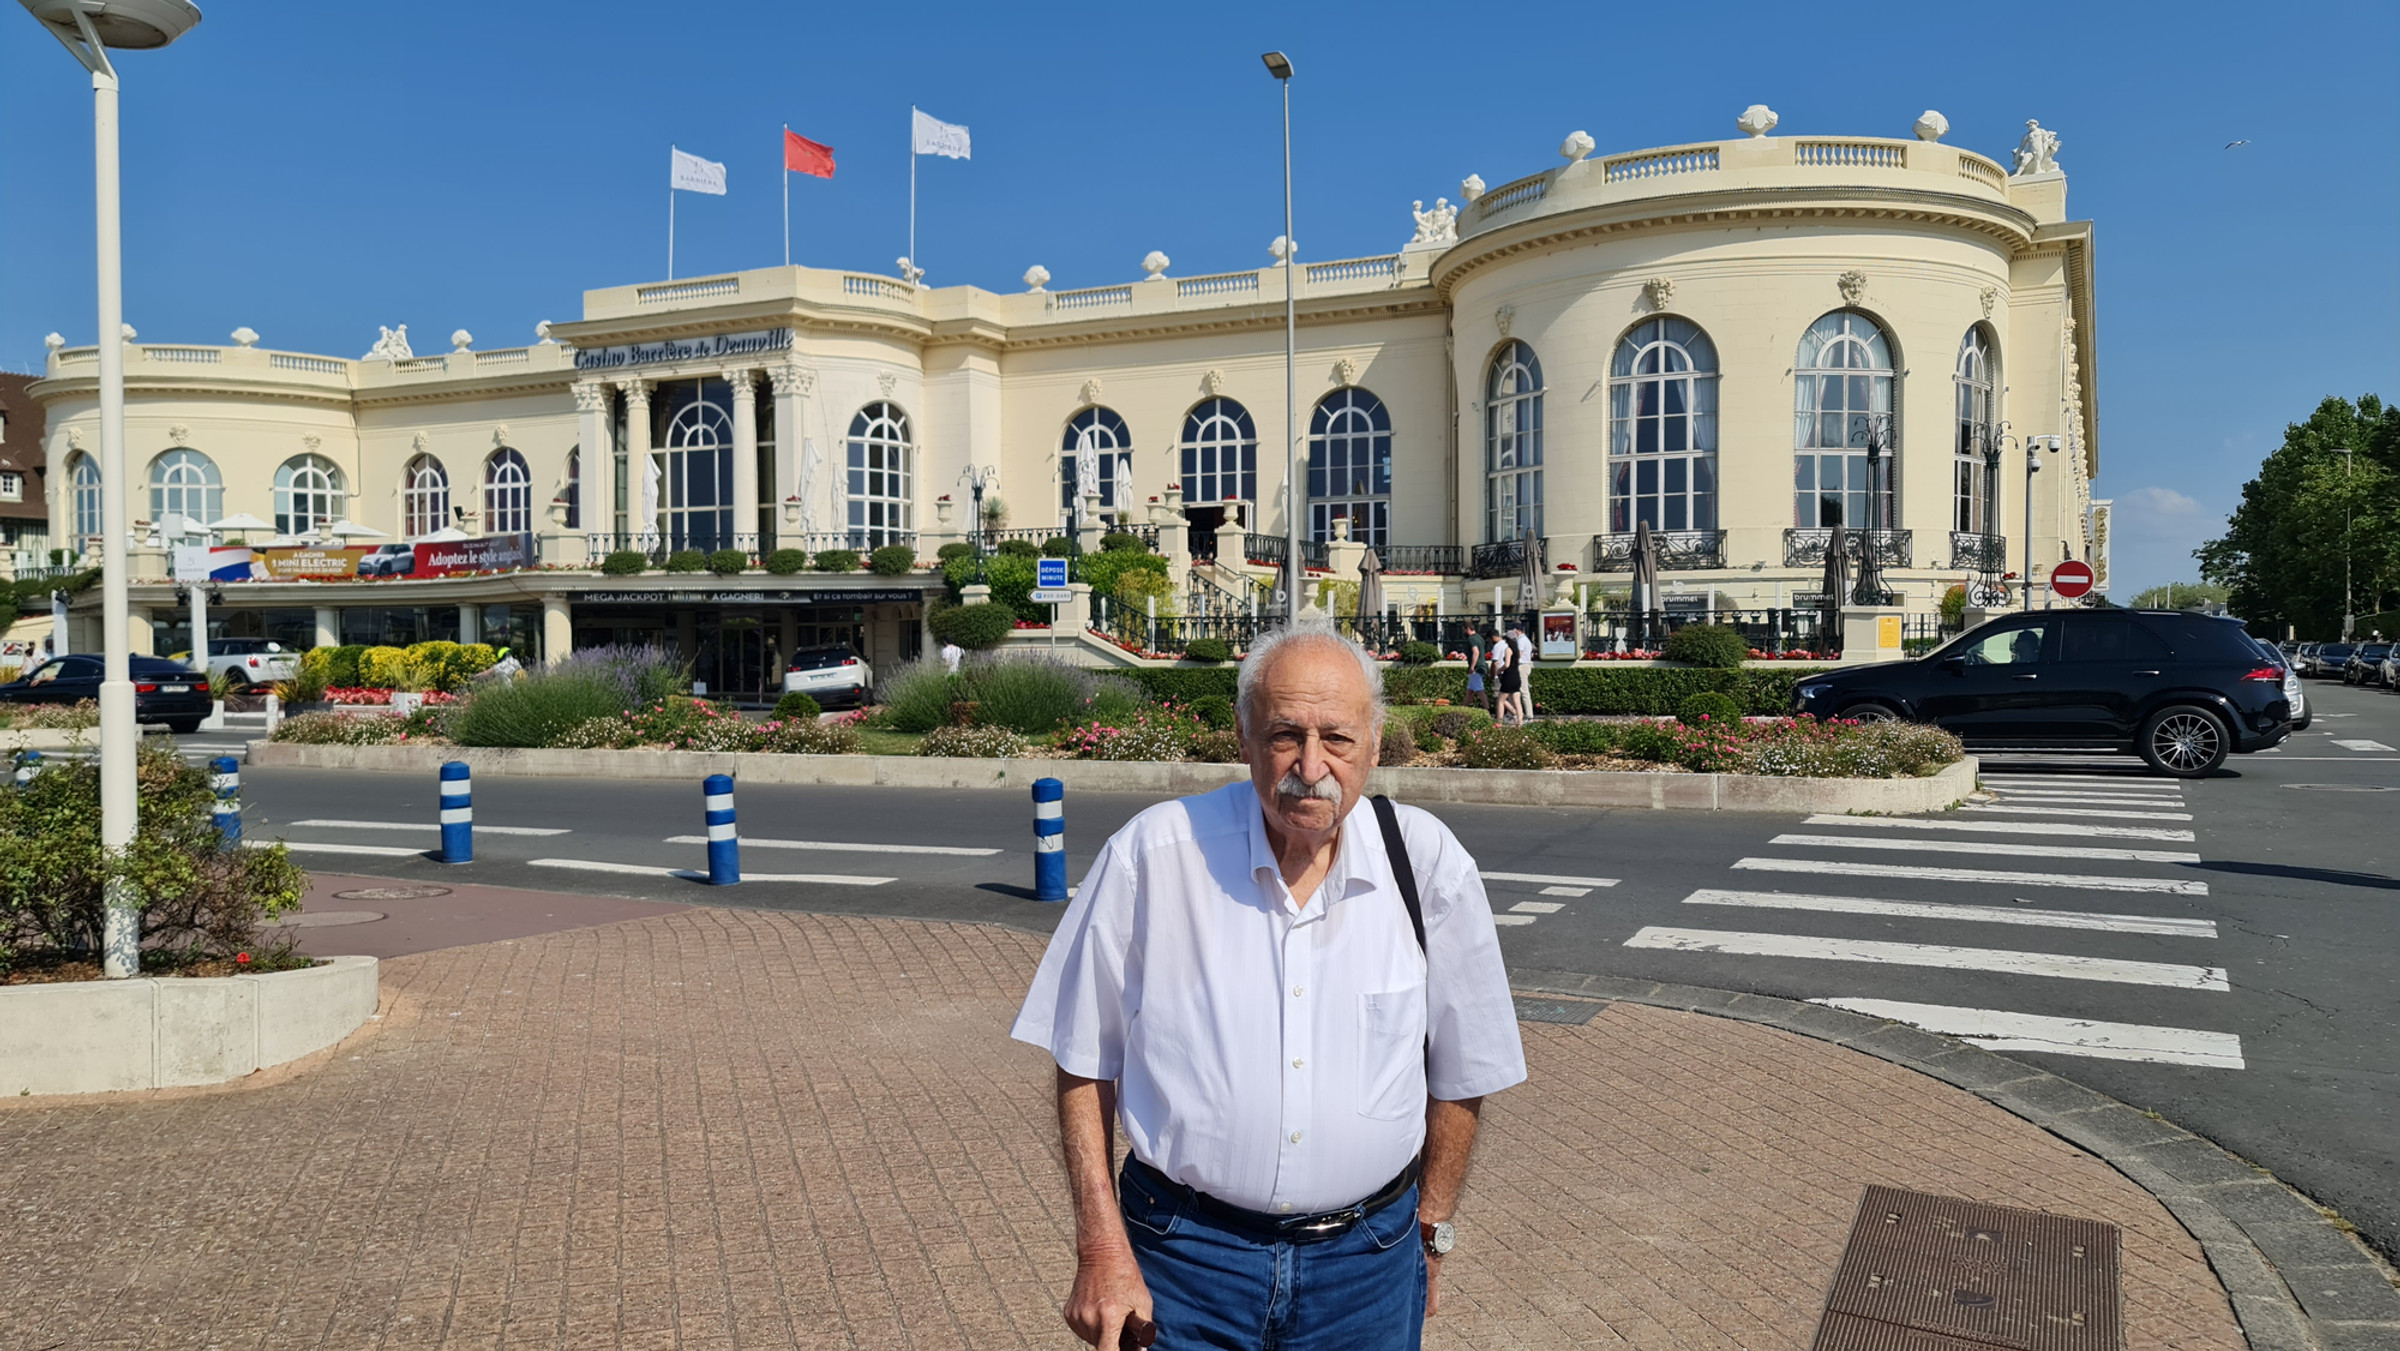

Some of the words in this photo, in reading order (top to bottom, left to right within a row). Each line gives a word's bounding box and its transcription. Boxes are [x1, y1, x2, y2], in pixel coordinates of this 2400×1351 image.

[573, 347, 625, 370] Casino
[629, 341, 692, 364] Barrière
[695, 341, 711, 358] de
[713, 327, 794, 357] Deauville
[278, 558, 300, 567] MINI
[301, 558, 348, 567] ELECTRIC
[428, 552, 468, 568] Adoptez
[469, 550, 478, 565] le
[480, 549, 498, 566] style
[584, 593, 617, 601] MEGA
[617, 593, 665, 601] JACKPOT
